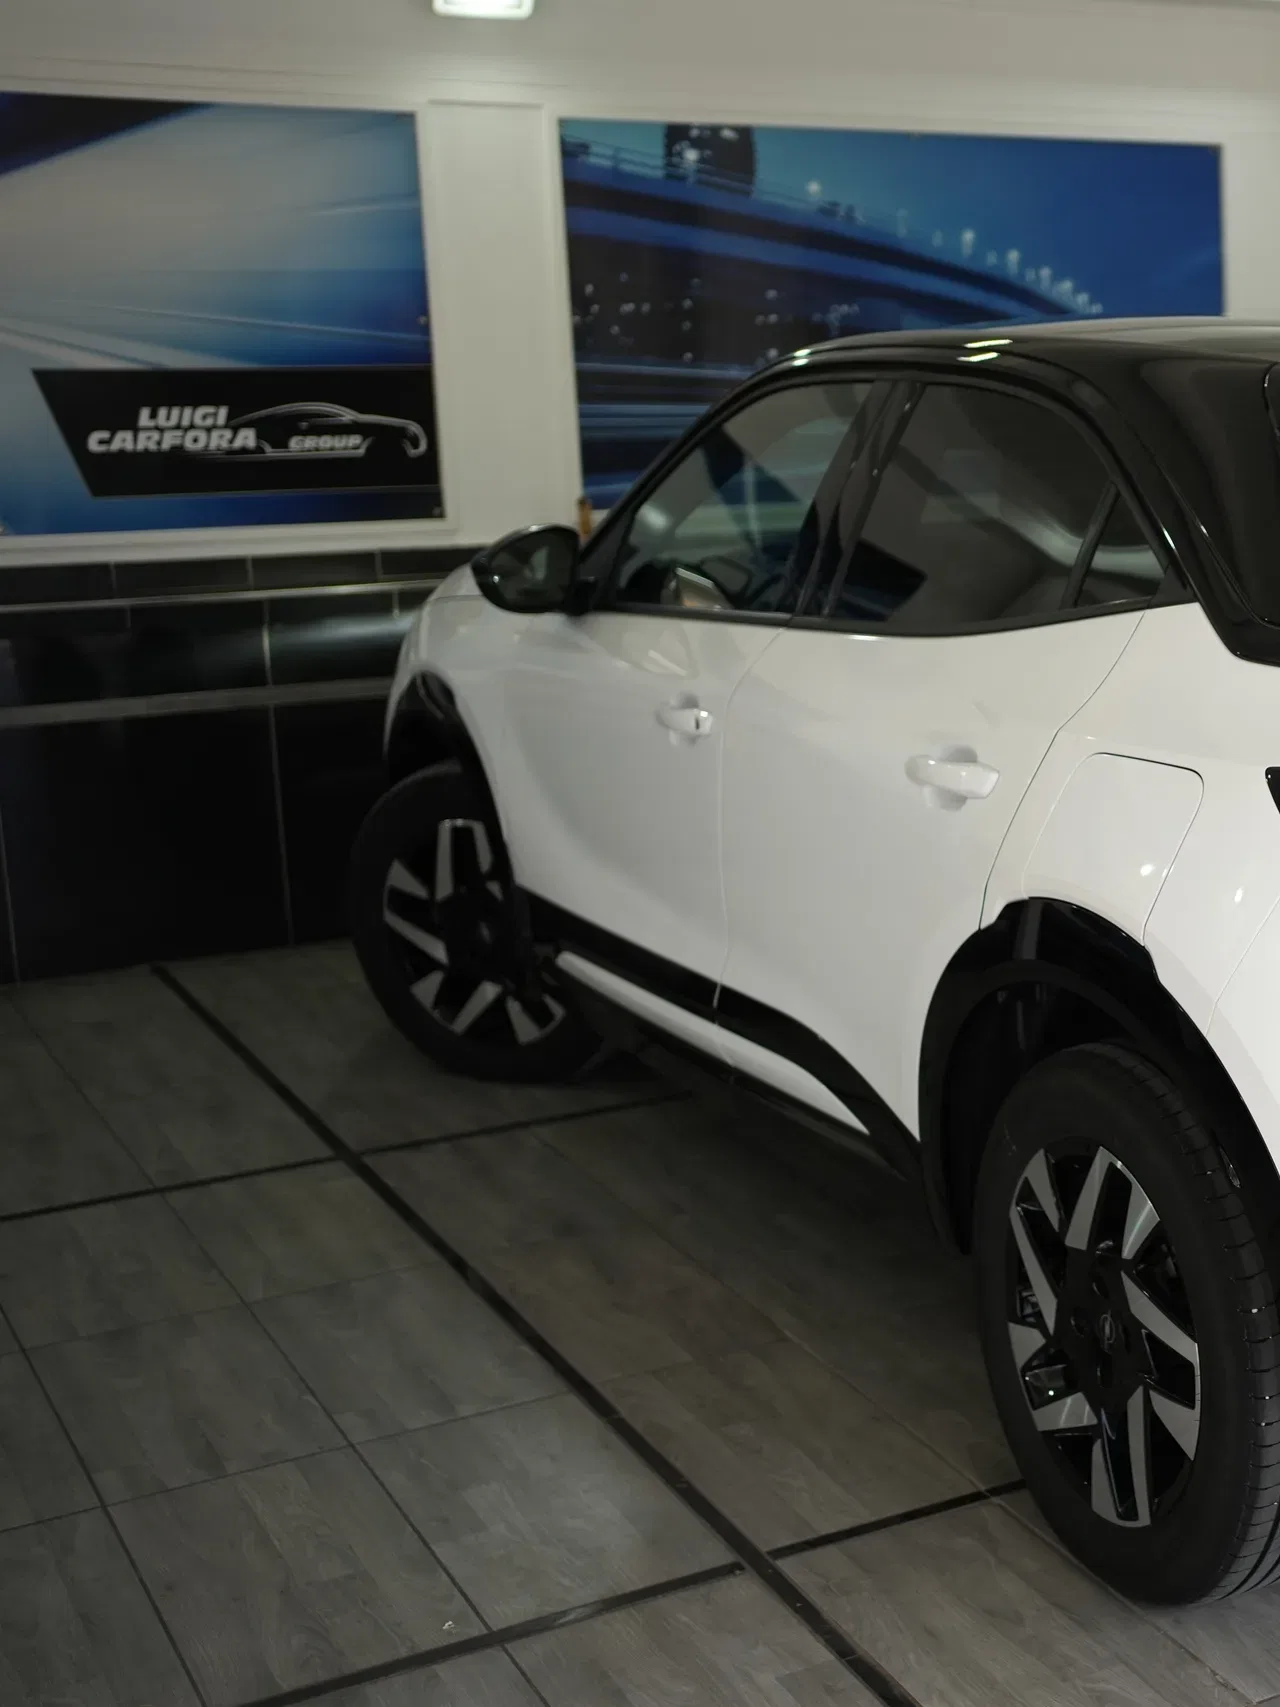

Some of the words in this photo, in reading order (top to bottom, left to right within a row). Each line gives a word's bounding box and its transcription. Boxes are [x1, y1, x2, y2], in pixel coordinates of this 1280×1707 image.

[137, 405, 229, 430] LUIGI
[87, 427, 257, 453] CARFORA
[288, 434, 364, 451] GROUP
